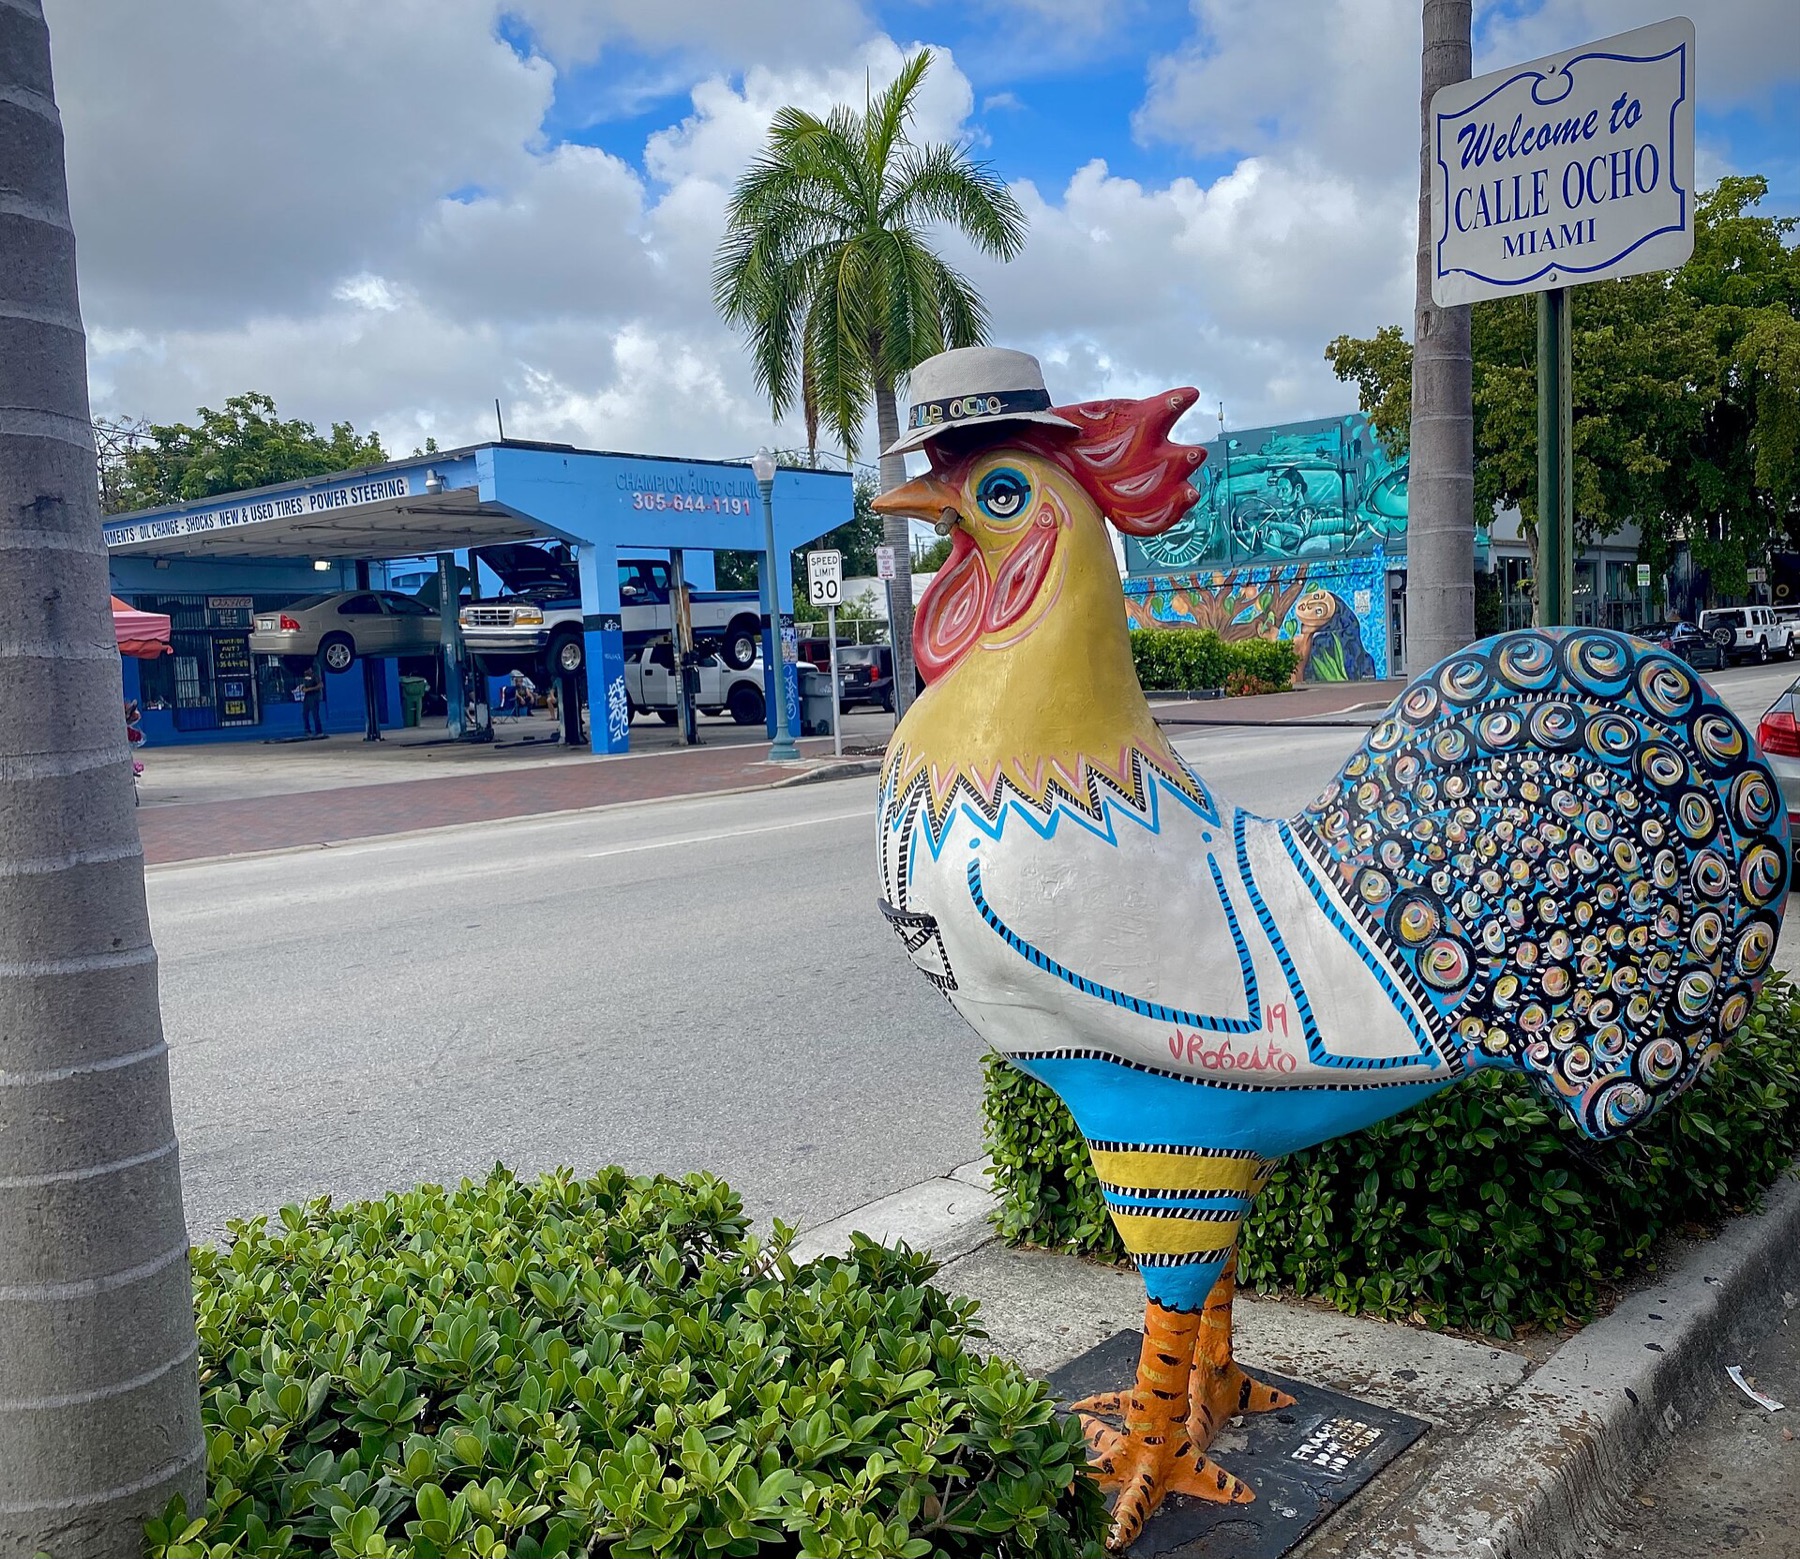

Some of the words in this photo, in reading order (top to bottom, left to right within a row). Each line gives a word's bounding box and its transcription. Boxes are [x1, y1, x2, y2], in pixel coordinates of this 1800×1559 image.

[1457, 109, 1599, 170] Welcome
[1608, 91, 1643, 134] to
[1454, 168, 1550, 233] CALLE
[1562, 143, 1660, 209] OCHO
[1501, 217, 1597, 260] MIAMI
[949, 396, 1002, 418] OCHO
[615, 472, 684, 494] CHAMPION
[687, 475, 720, 496] AUTO
[724, 481, 761, 499] CLINIC
[139, 523, 152, 540] OIL
[152, 520, 180, 539] CHANGE
[185, 513, 214, 532] SHOCKS
[219, 509, 239, 527] NEW
[241, 508, 249, 522] &
[250, 503, 274, 521] USED
[275, 498, 303, 517] TIRES
[310, 489, 348, 512] POWER
[350, 479, 405, 504] STEERING
[632, 492, 750, 515] 305-644-1191
[811, 556, 838, 566] SPEED
[814, 568, 835, 577] LIMIT
[813, 580, 838, 599] 30
[1266, 1002, 1289, 1038] 19
